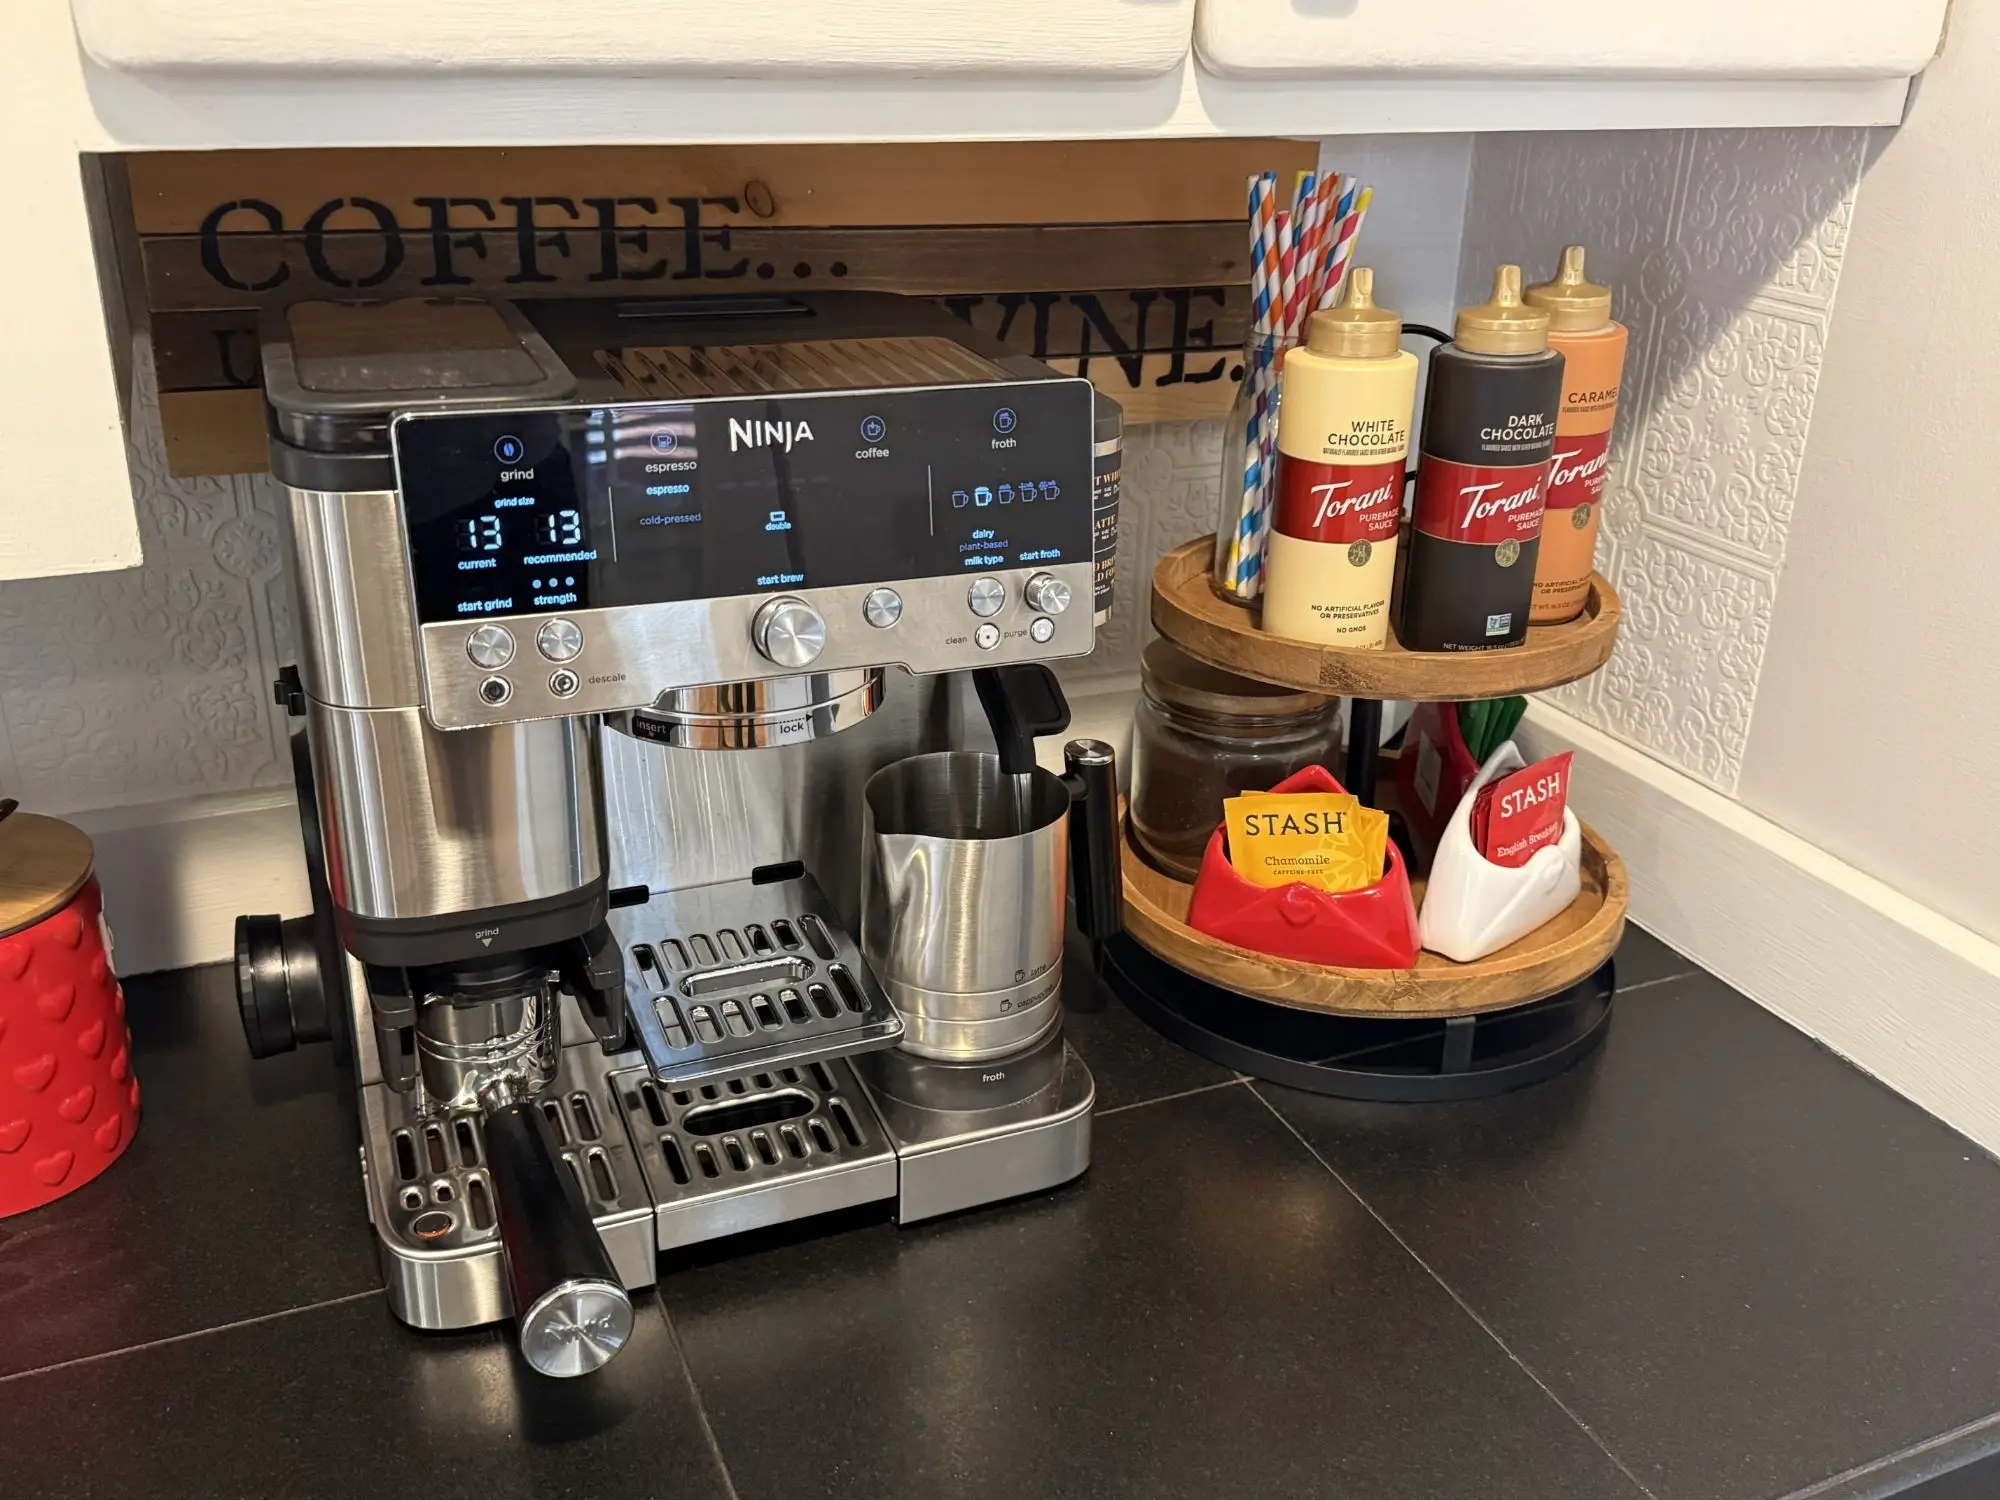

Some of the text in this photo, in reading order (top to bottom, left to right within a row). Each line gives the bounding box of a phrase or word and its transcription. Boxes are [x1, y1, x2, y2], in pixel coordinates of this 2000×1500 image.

[1568, 387, 1618, 404] CARAME
[1351, 419, 1394, 433] WHITE
[1508, 413, 1544, 428] DARK
[728, 417, 815, 454] NINJA
[1327, 430, 1405, 446] CHOCOLATE
[1480, 422, 1555, 441] CHOCOLATE
[991, 438, 1017, 450] froth
[855, 447, 890, 459] coffee
[645, 460, 698, 474] espresso
[500, 468, 535, 483] grind
[646, 484, 690, 496] espresso
[494, 496, 535, 509] grind size
[1311, 475, 1395, 528] Torani
[1460, 476, 1542, 528] Torani
[639, 512, 703, 527] cold-pressed
[1094, 514, 1116, 530] ATTE
[1508, 508, 1544, 523] PUREMAD
[549, 510, 581, 545] 13
[765, 521, 792, 531] double
[1368, 519, 1393, 532] SAUCE
[1516, 518, 1540, 531] SAUCE
[468, 515, 503, 551] 13
[972, 529, 995, 540] dairy
[960, 540, 1009, 553] plant-based
[523, 549, 598, 565] recommended
[964, 555, 1004, 567] milk type
[1019, 549, 1061, 561] start froth
[457, 558, 497, 571] current
[757, 573, 805, 586] start brew
[457, 598, 513, 613] start grind
[533, 593, 577, 606] strength
[1311, 604, 1323, 612] NO
[1333, 608, 1380, 620] PRESERVATIVES
[945, 636, 968, 645] clean
[1003, 629, 1028, 639] purge
[1443, 642, 1457, 650] NET
[588, 672, 627, 685] descale
[780, 721, 804, 734] lock
[1501, 771, 1561, 818] STASH
[1245, 812, 1344, 836] STASH
[1497, 837, 1527, 857] English
[1264, 855, 1330, 866] Chamomile
[474, 927, 499, 939] grind
[982, 1071, 1005, 1083] froth
